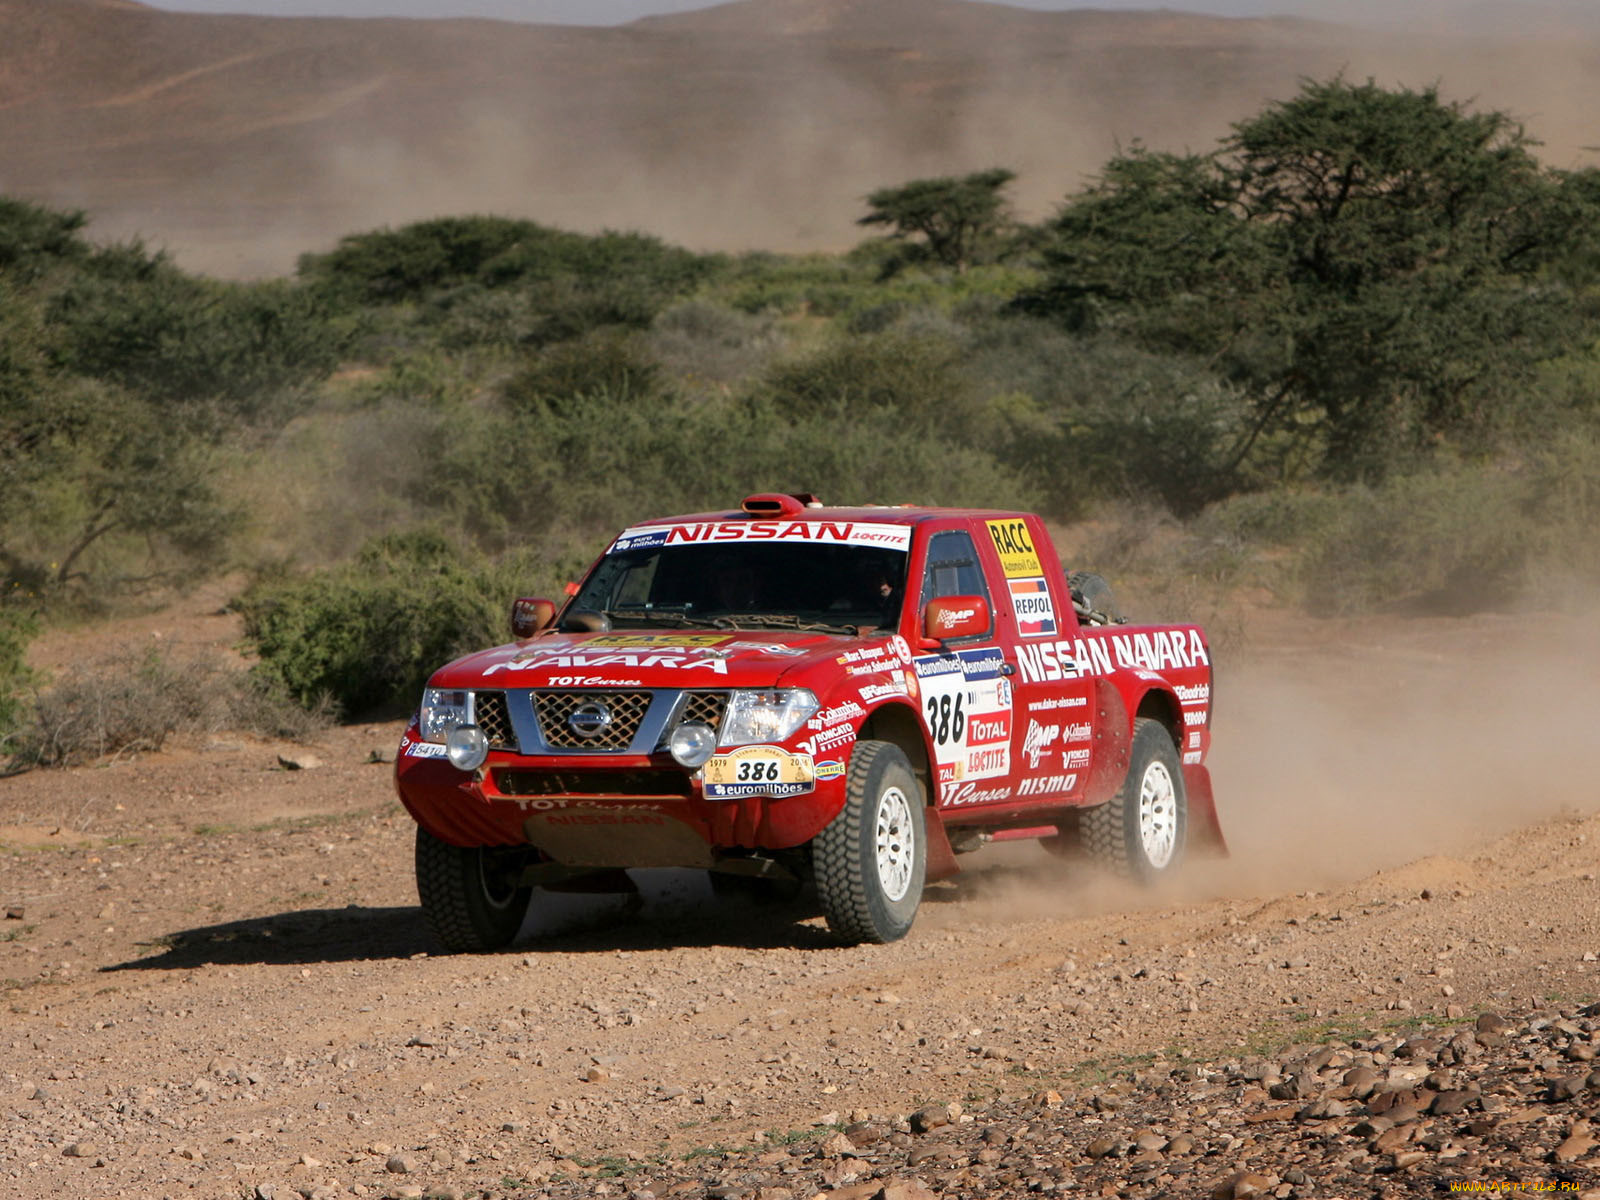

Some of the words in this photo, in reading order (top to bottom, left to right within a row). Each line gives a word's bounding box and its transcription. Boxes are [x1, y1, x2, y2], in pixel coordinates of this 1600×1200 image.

[666, 522, 853, 543] NISSAN
[851, 532, 907, 543] LOCTITE
[990, 523, 1032, 554] RACC
[1016, 598, 1051, 614] REPSOL
[482, 655, 728, 676] NAVARA
[1014, 636, 1115, 683] NISSAN
[1112, 629, 1209, 671] NAVARA
[927, 691, 965, 745] 386
[815, 723, 853, 743] RONCATO
[971, 720, 1007, 740] TOTAL
[710, 759, 727, 767] 1979
[968, 749, 1006, 773] LOCTITE
[737, 762, 779, 781] 386
[727, 783, 803, 795] euromilhões
